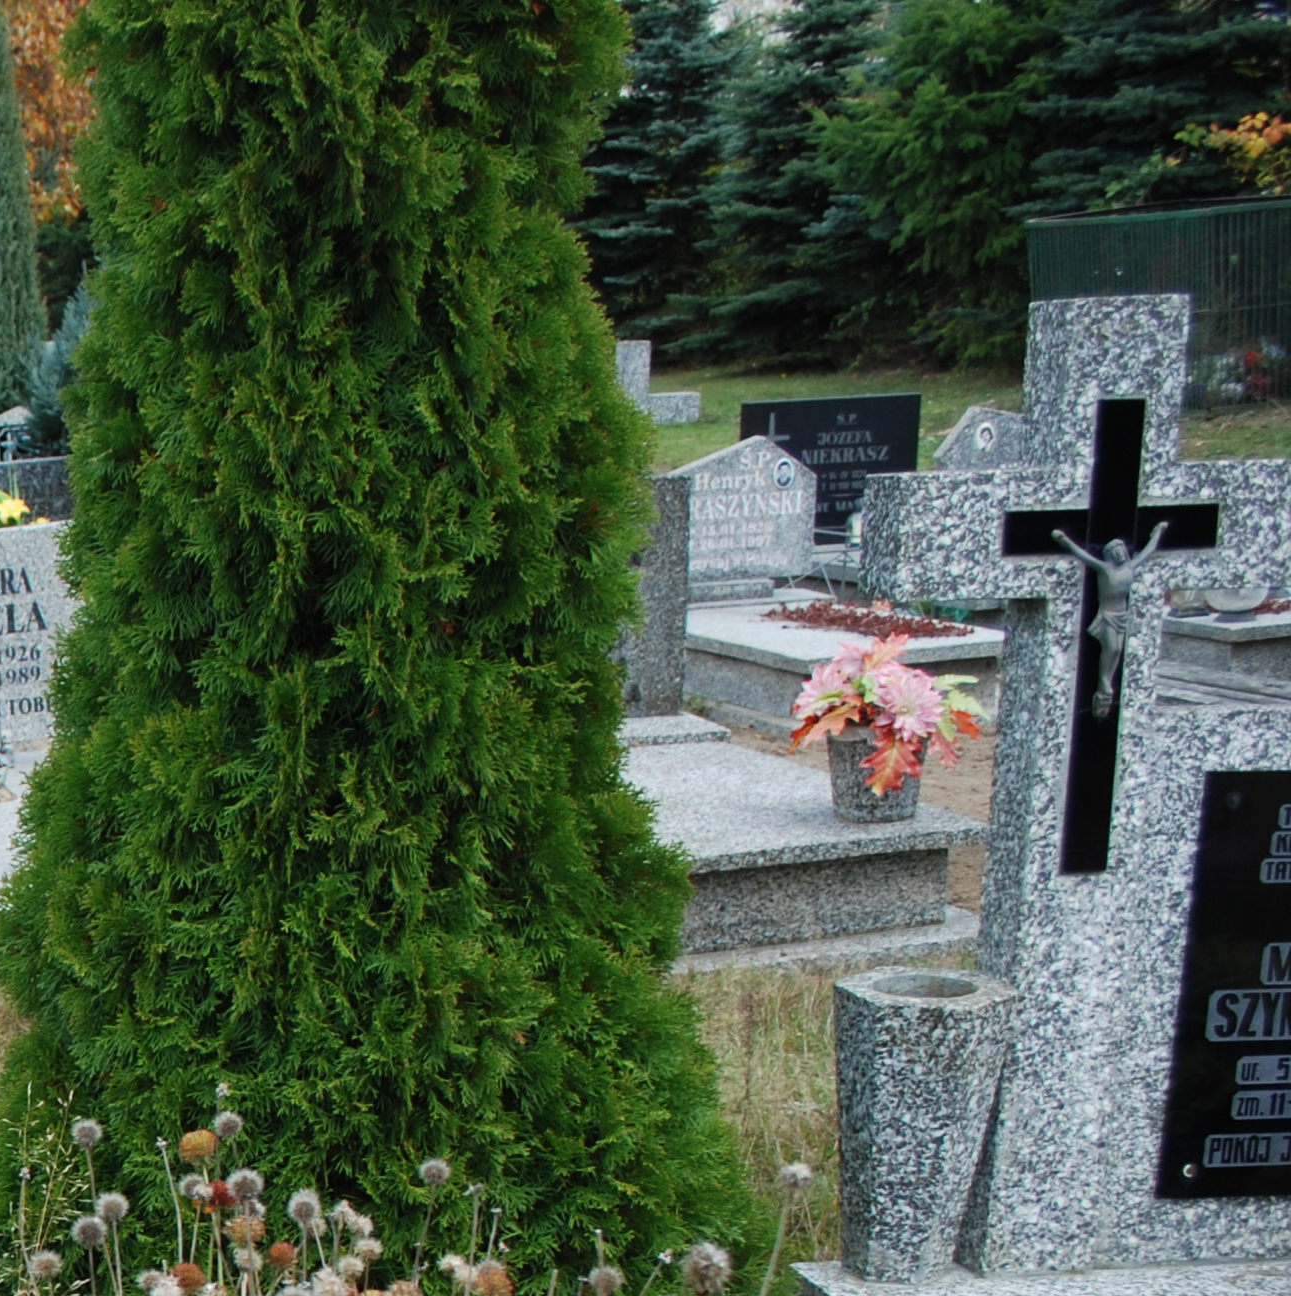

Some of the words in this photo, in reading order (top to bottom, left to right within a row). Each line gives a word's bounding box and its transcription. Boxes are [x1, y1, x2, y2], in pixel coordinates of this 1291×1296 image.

[800, 445, 890, 465] NIEKRASZ
[694, 470, 766, 492] Henryk
[1235, 1096, 1264, 1118] zm.
